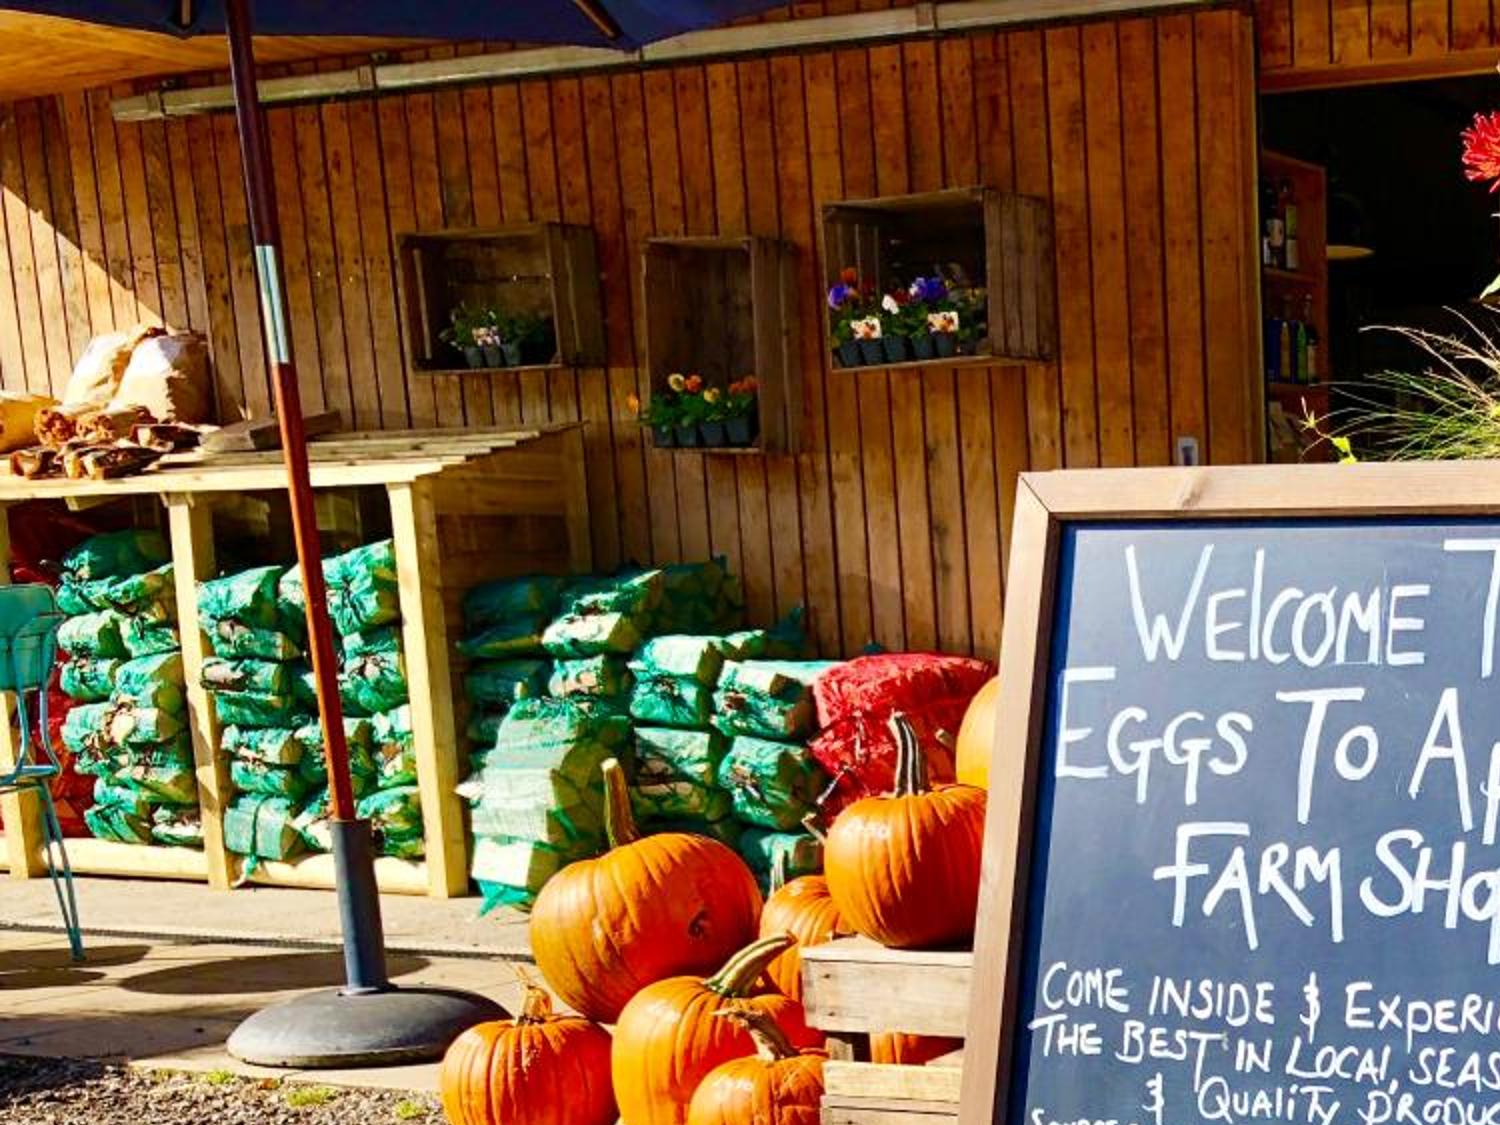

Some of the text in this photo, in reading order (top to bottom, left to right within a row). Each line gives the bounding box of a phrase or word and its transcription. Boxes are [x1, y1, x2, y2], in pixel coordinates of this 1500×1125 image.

[1055, 667, 1253, 805] EGGS
[1153, 822, 1344, 950] FARM
[1042, 961, 1130, 1012] COME
[1149, 976, 1275, 1027] INSIDE
[1029, 1014, 1102, 1057] THE
[1116, 1021, 1224, 1092] BEST
[1236, 1040, 1272, 1074] IN
